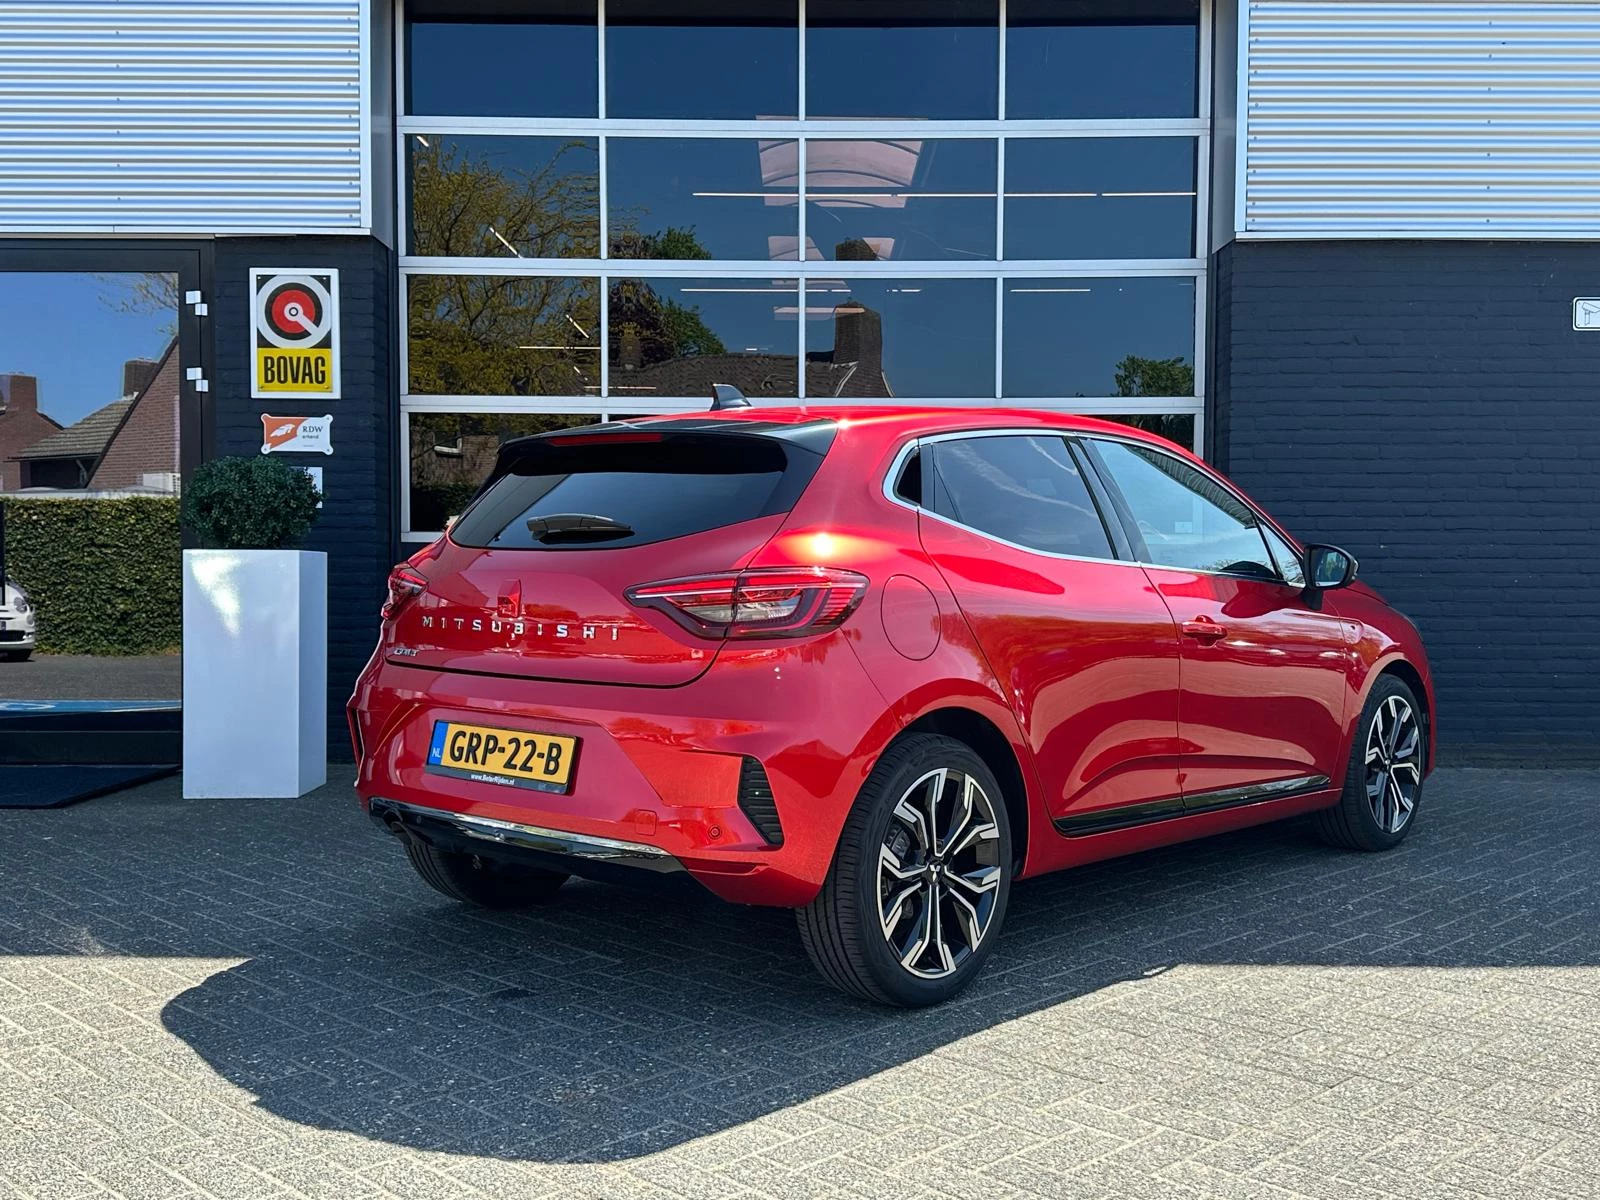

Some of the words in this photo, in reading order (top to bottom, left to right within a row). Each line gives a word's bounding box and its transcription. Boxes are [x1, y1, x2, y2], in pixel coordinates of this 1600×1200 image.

[263, 355, 326, 384] BOVAG
[422, 616, 618, 641] MITSUBISHI
[431, 747, 441, 758] NL
[449, 730, 563, 776] GRP-22-B
